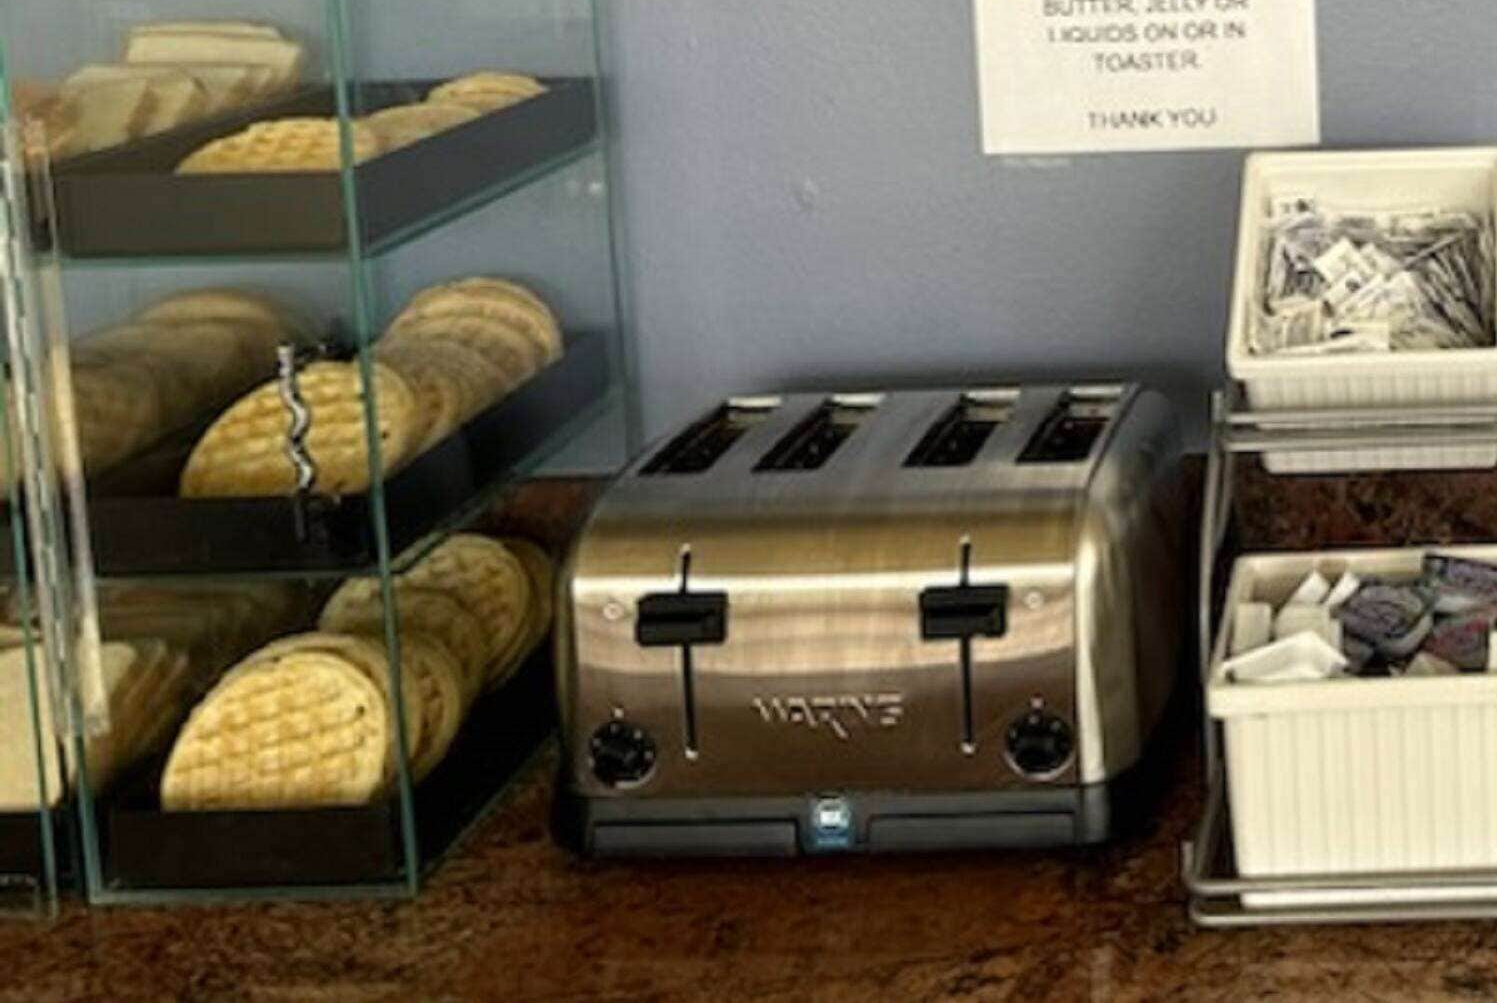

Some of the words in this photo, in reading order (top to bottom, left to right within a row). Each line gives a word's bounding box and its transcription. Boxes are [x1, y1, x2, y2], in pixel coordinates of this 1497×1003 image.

[1047, 24, 1138, 43] LIQUIDS
[1143, 21, 1178, 42] ON
[1183, 19, 1218, 40] OR
[1223, 19, 1246, 39] IN
[1088, 110, 1163, 129] THANK
[1167, 107, 1218, 128] YOU
